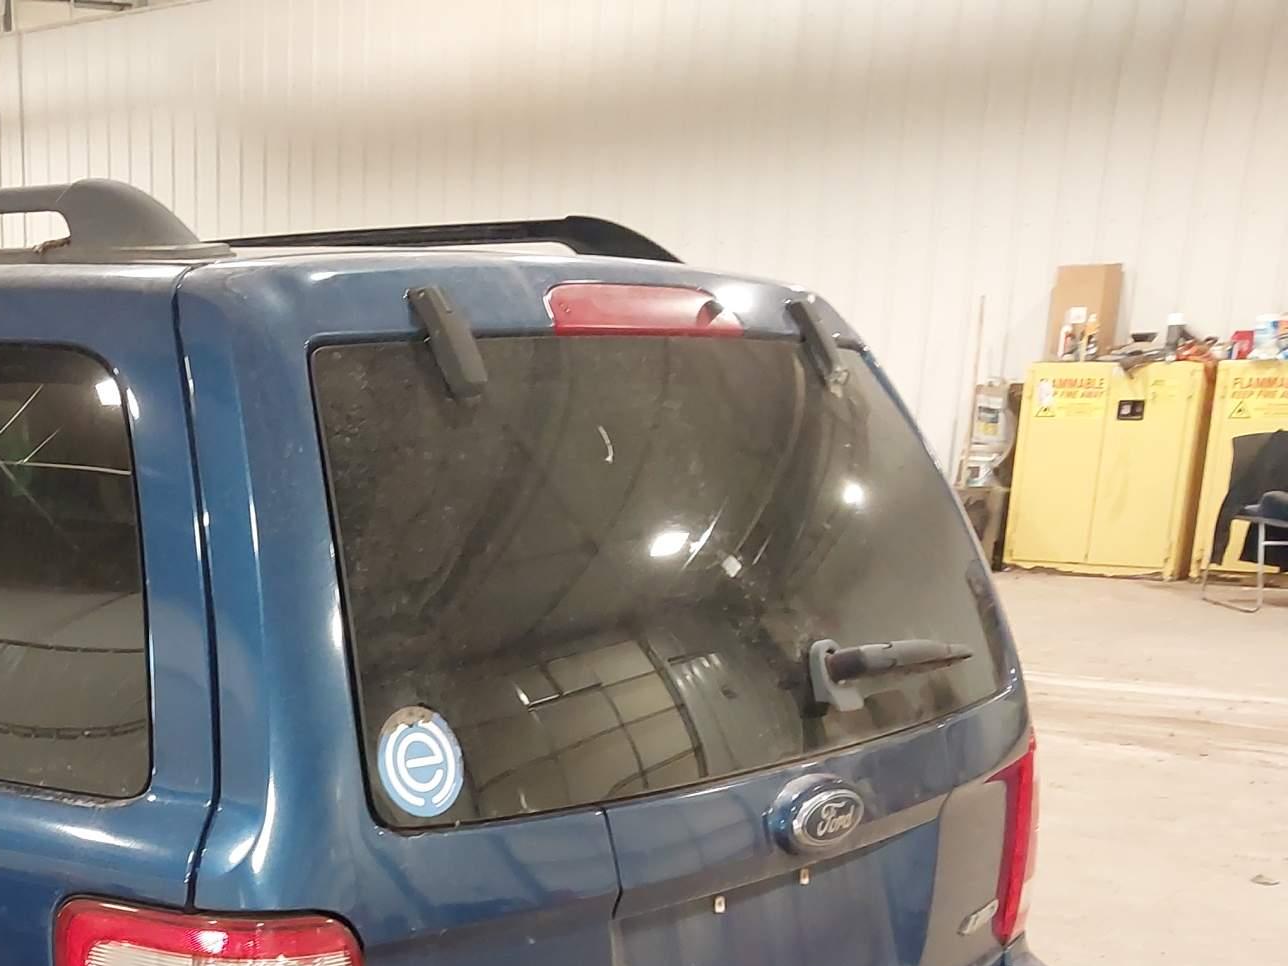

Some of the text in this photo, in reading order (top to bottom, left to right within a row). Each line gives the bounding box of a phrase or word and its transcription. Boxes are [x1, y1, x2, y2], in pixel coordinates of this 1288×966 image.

[1039, 378, 1105, 389] AMMABLE
[1233, 377, 1288, 389] FLAMMA
[817, 801, 855, 837] Ford
